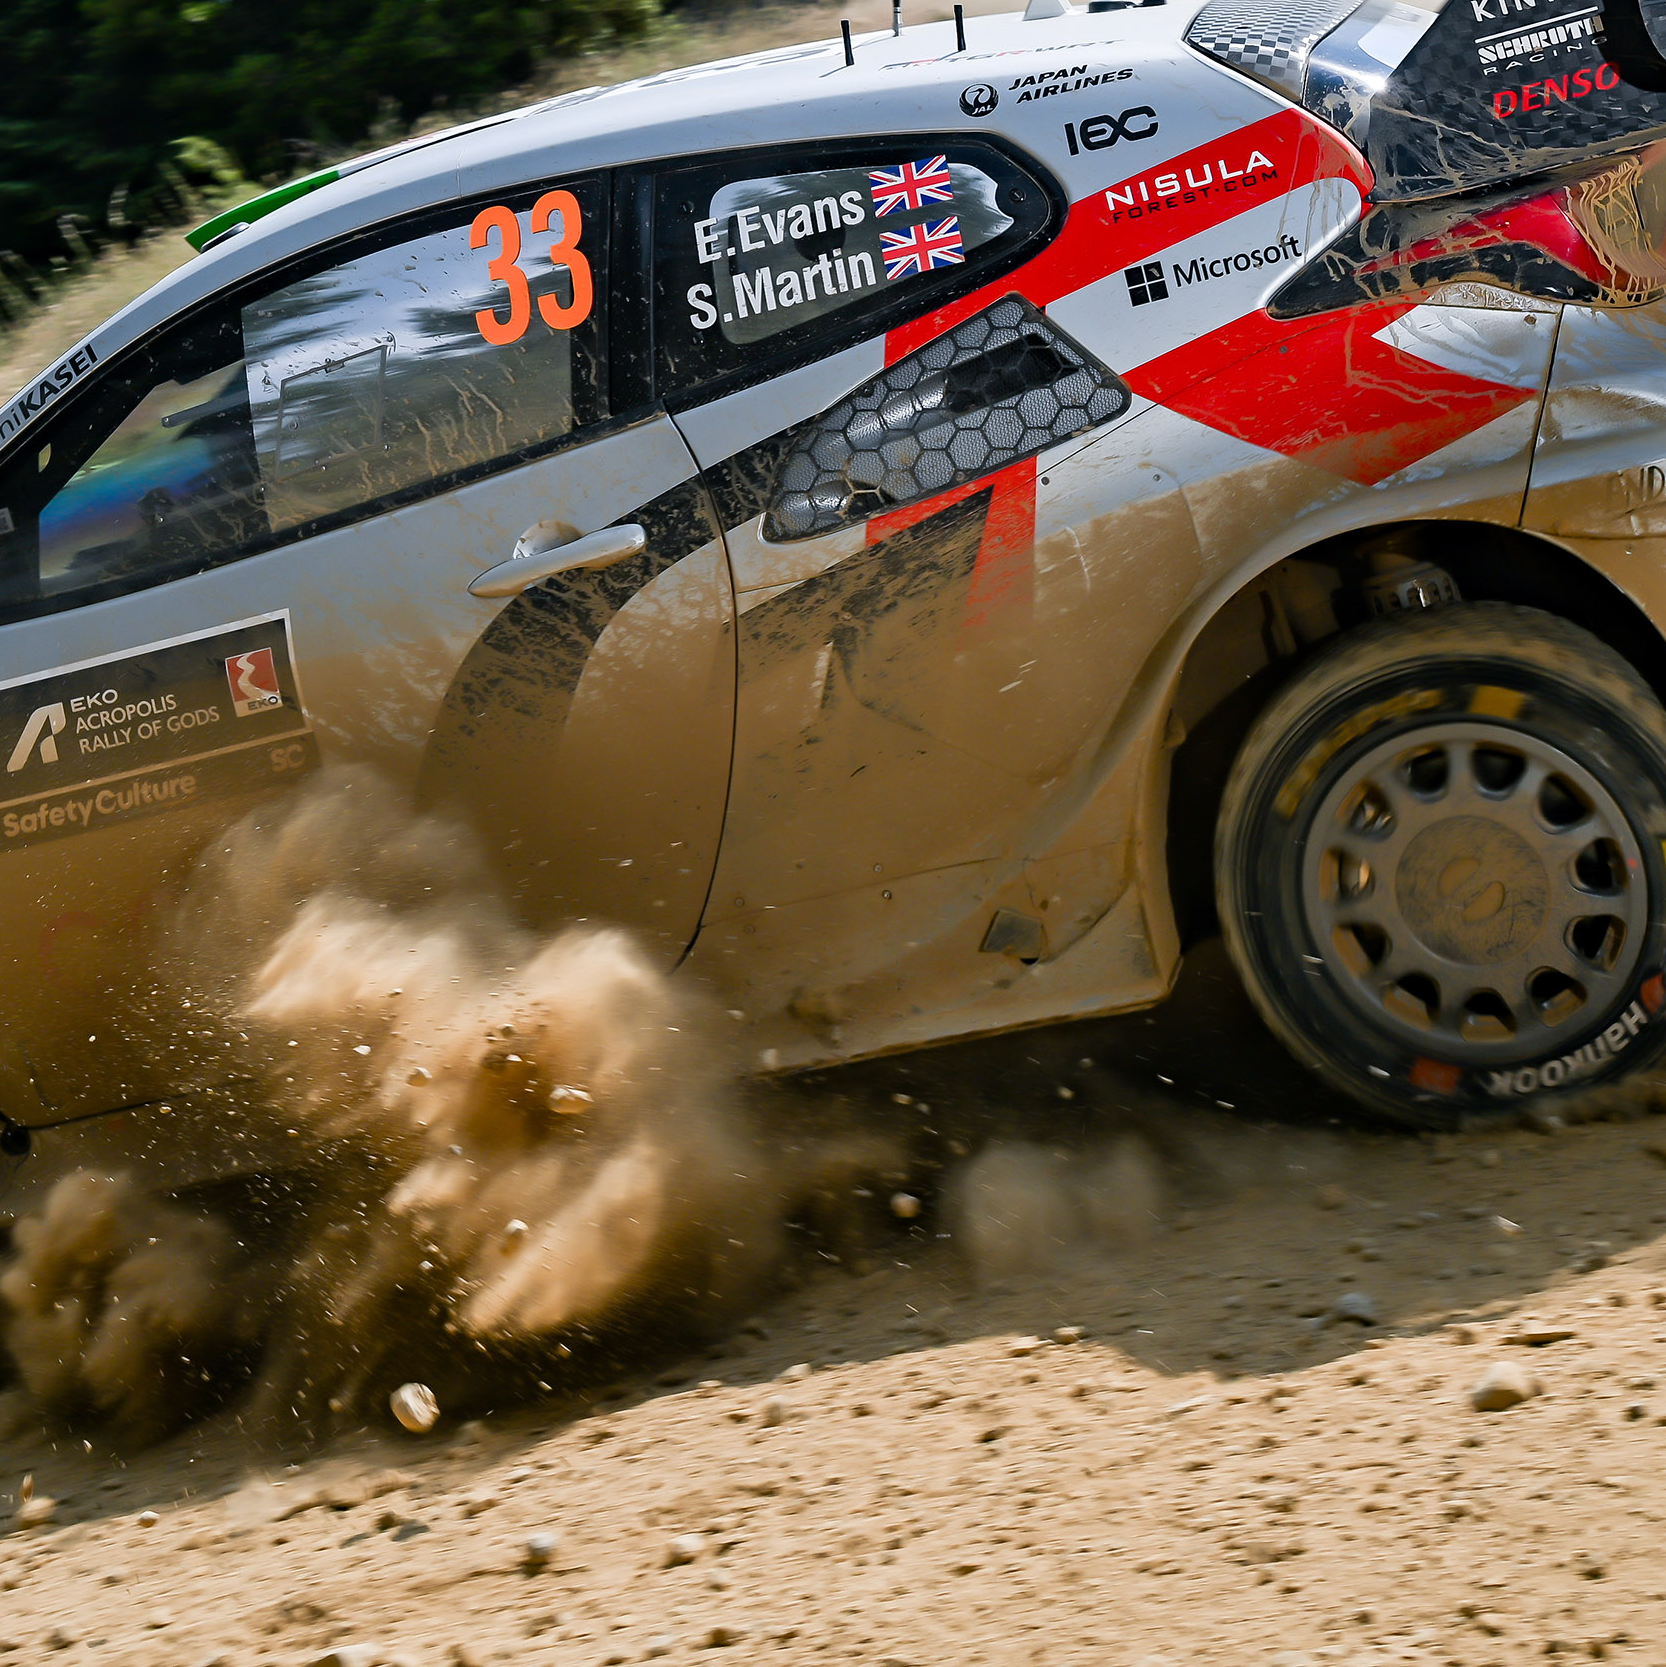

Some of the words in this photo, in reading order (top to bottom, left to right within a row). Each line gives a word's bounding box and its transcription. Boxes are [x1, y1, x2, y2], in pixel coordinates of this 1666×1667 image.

[1477, 15, 1605, 65] SCHROTH
[1008, 64, 1088, 91] JAPAN
[1016, 68, 1134, 104] AIRLINES
[1492, 62, 1621, 120] DENSO
[972, 104, 994, 115] JAL
[1105, 150, 1275, 211] NISULA
[693, 190, 866, 265] E.Evans
[469, 190, 594, 345] 33
[1172, 234, 1302, 288] Microsoft
[686, 247, 877, 330] S.Martin
[70, 688, 119, 713] EKO
[76, 694, 177, 734] ACROPOLIS
[247, 695, 278, 712] EKO
[79, 726, 132, 755] RALLY
[137, 719, 163, 740] OF
[166, 706, 220, 732] GODS
[270, 744, 306, 772] SC
[3, 773, 199, 839] SafetyCulture
